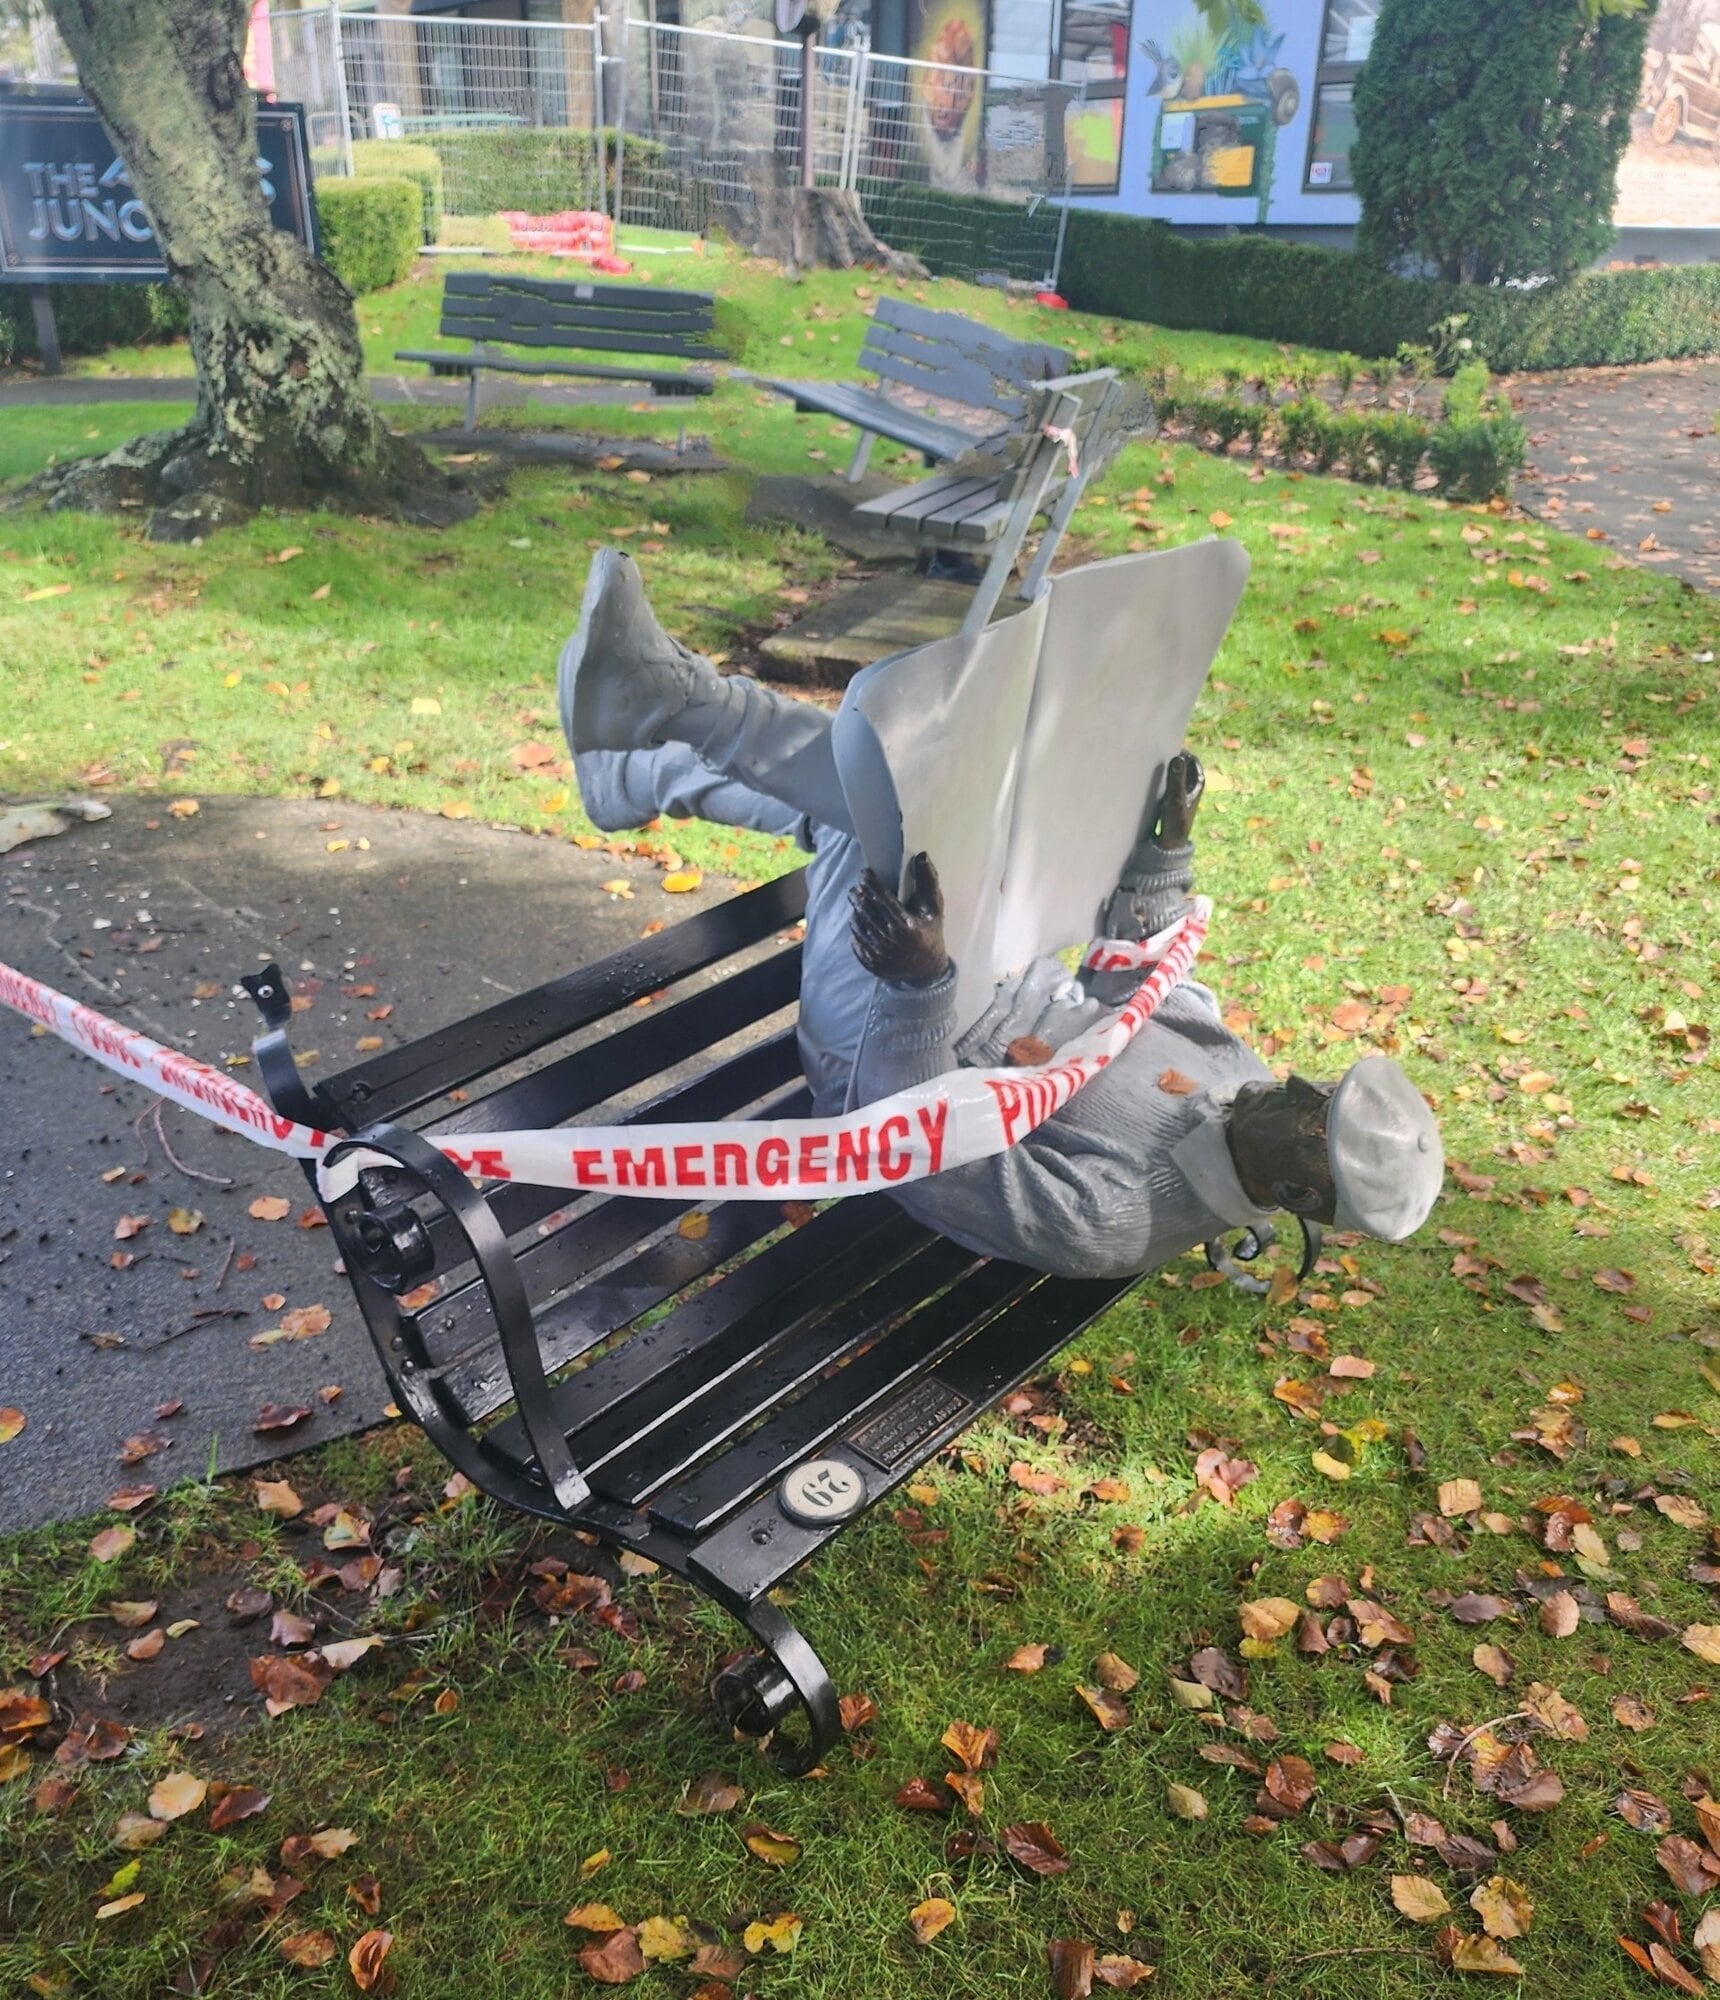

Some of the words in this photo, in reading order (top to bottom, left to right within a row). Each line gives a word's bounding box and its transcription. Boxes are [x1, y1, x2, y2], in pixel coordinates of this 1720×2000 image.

[22, 162, 99, 197] THE
[28, 198, 154, 241] JUNC
[573, 1097, 948, 1187] EMERGENCY
[801, 1467, 851, 1507] 29
